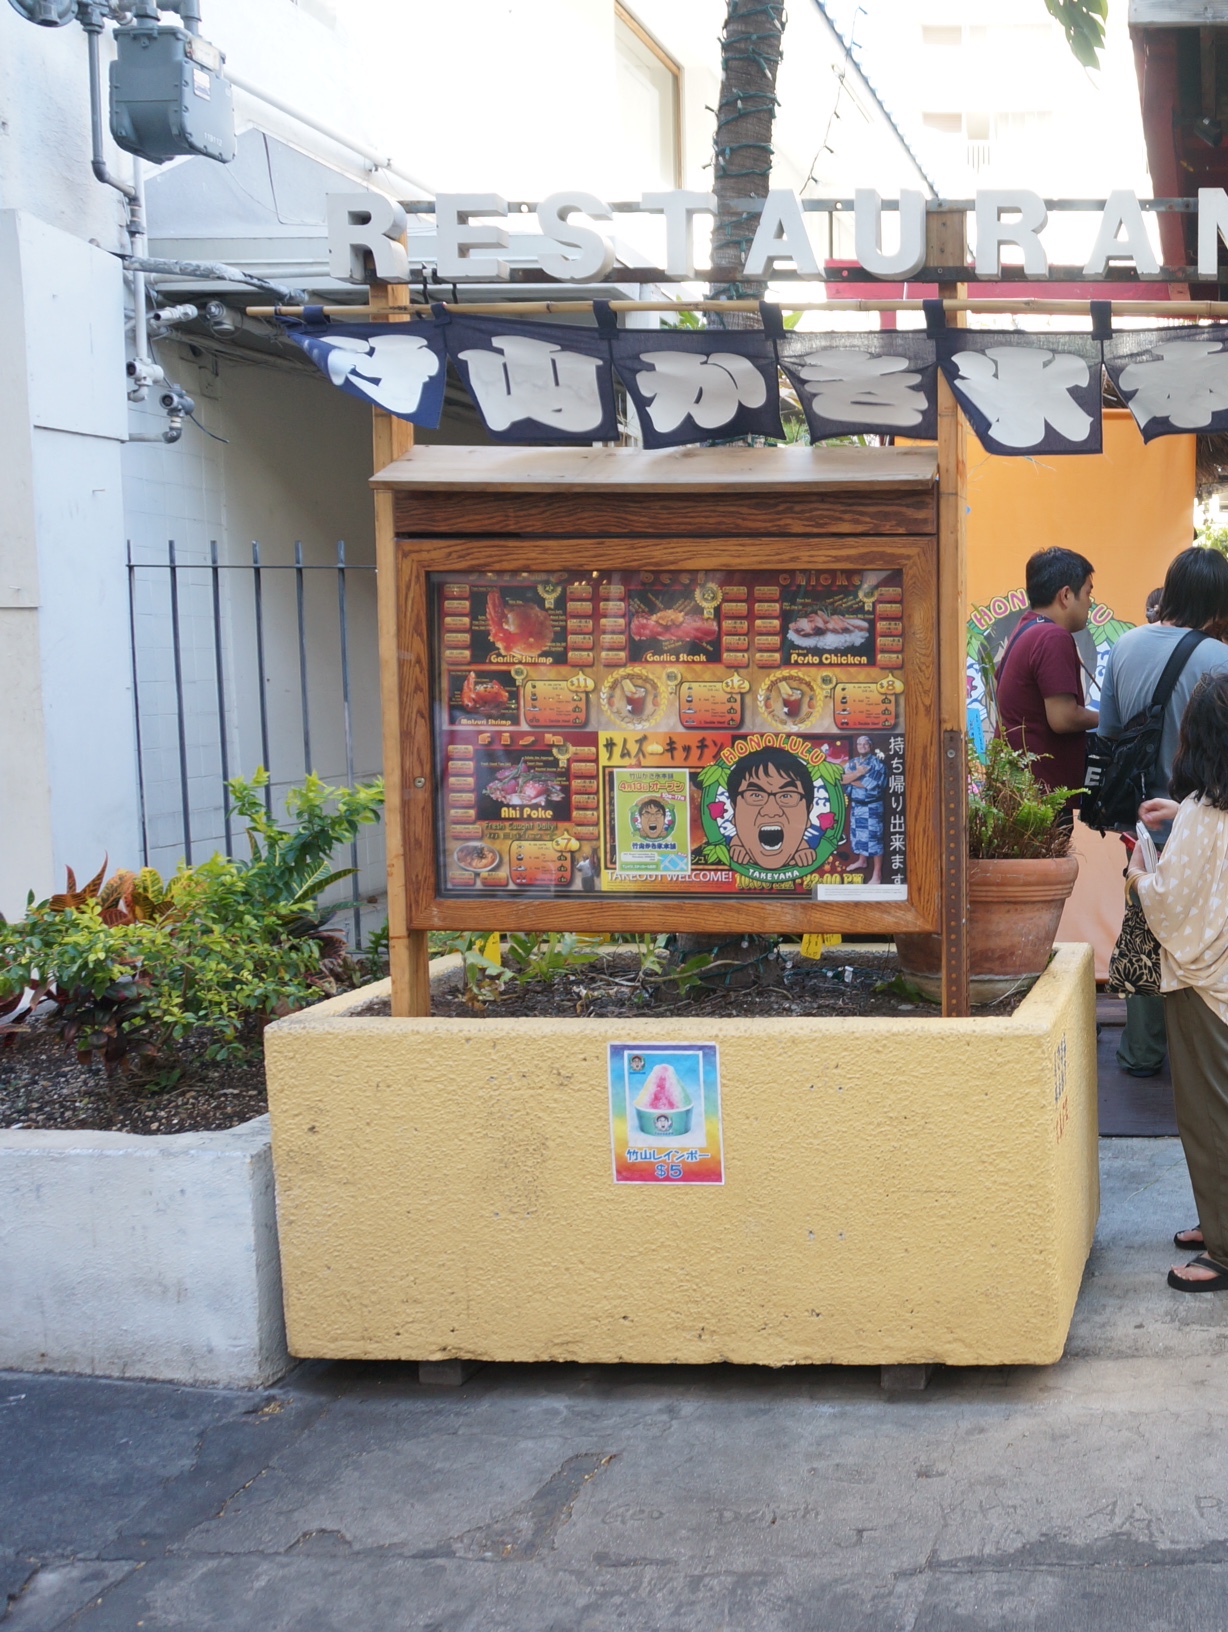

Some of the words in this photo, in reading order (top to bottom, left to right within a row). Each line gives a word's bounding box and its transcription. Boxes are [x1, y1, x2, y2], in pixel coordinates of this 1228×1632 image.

[490, 654, 520, 664] Garlic
[521, 654, 553, 664] Shrimp
[646, 652, 676, 662] Garlic
[678, 652, 707, 662] Steak
[790, 653, 820, 664] Pesto
[821, 653, 868, 664] Chicken
[569, 678, 589, 689] $11
[724, 678, 746, 690] $12
[879, 680, 896, 691] $8
[603, 734, 647, 762] サムズ
[664, 735, 725, 762] キッチン
[720, 732, 826, 767] HONOLULU
[649, 780, 685, 792] オープン
[500, 806, 520, 819] Ahi
[523, 806, 554, 819] Poke
[888, 736, 905, 884] 持ち帰り出来ます
[554, 837, 572, 850] $7
[606, 871, 666, 882] TAKEOUT
[667, 870, 733, 882] WELCOME!
[748, 868, 800, 881] TAKEYAMA
[626, 1148, 710, 1162] 竹山レインボー
[655, 1163, 683, 1178] $5
